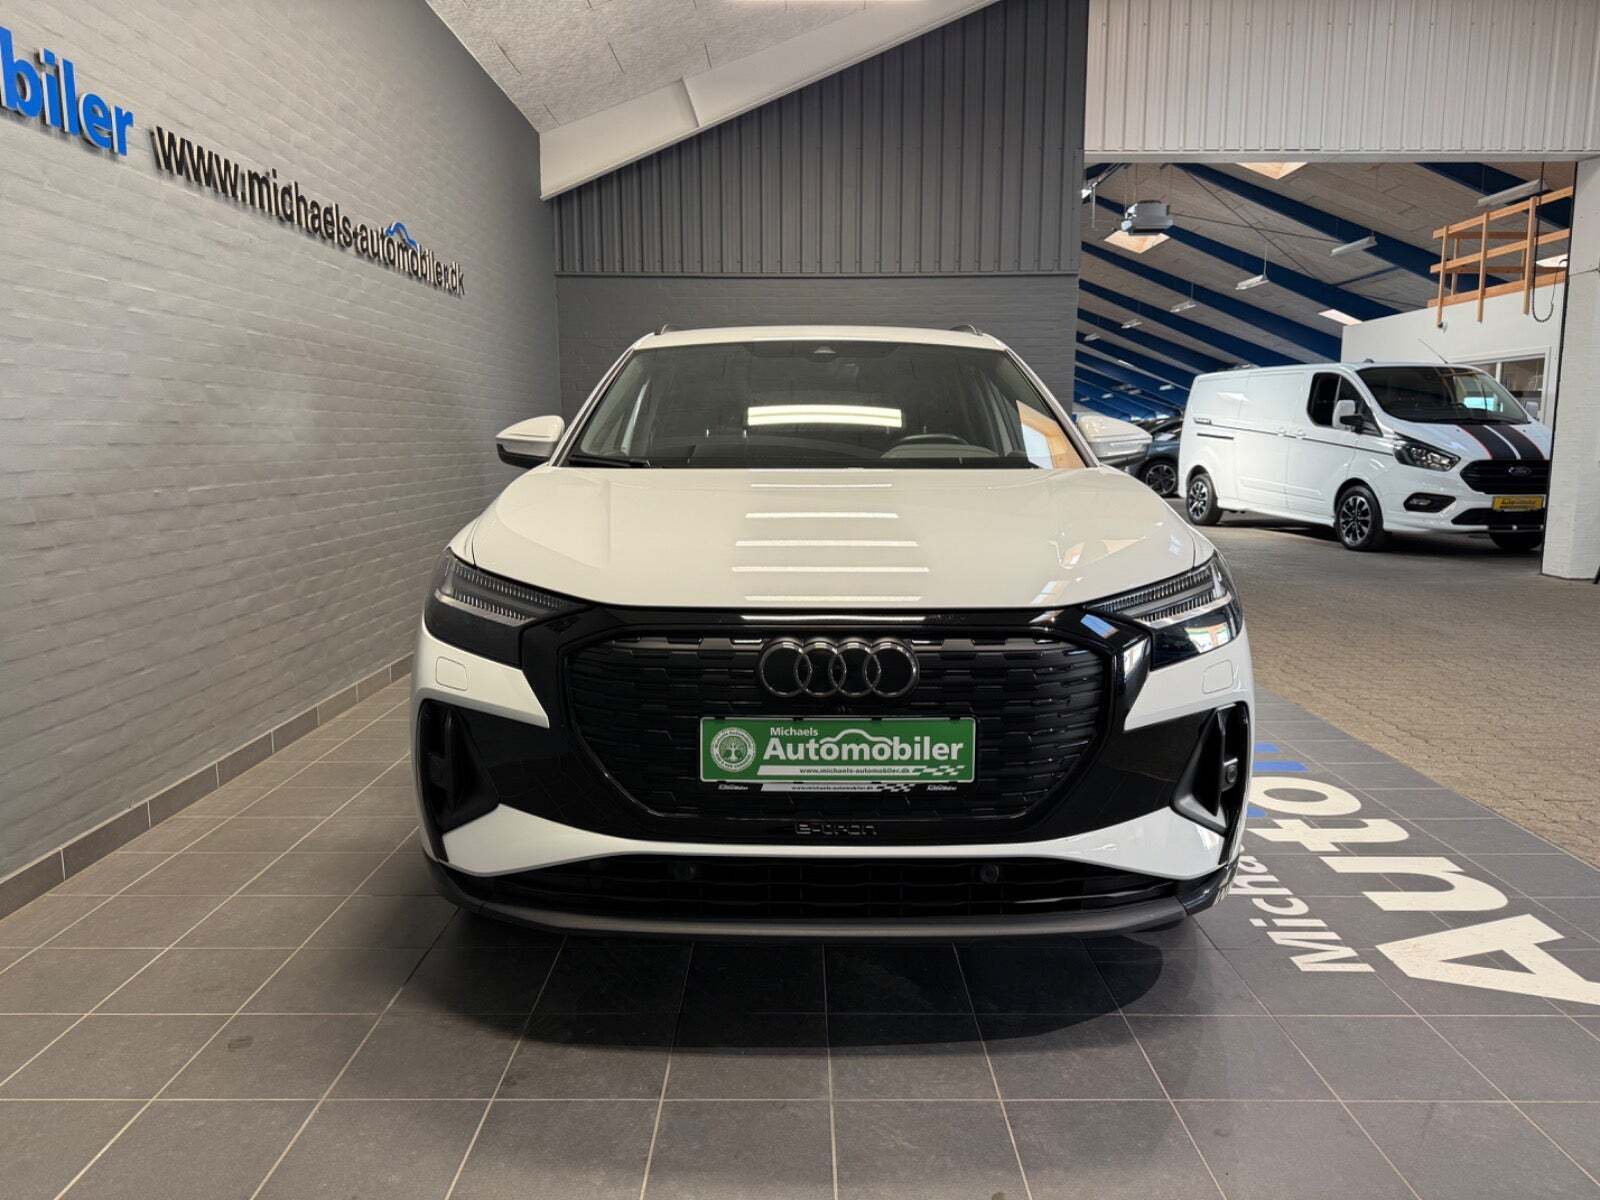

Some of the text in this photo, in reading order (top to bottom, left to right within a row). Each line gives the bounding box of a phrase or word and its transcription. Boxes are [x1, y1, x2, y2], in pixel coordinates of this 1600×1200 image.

[149, 126, 466, 296] www.michaels-automobiler.dk
[769, 726, 819, 737] Michaels
[763, 735, 965, 761] Automobiler
